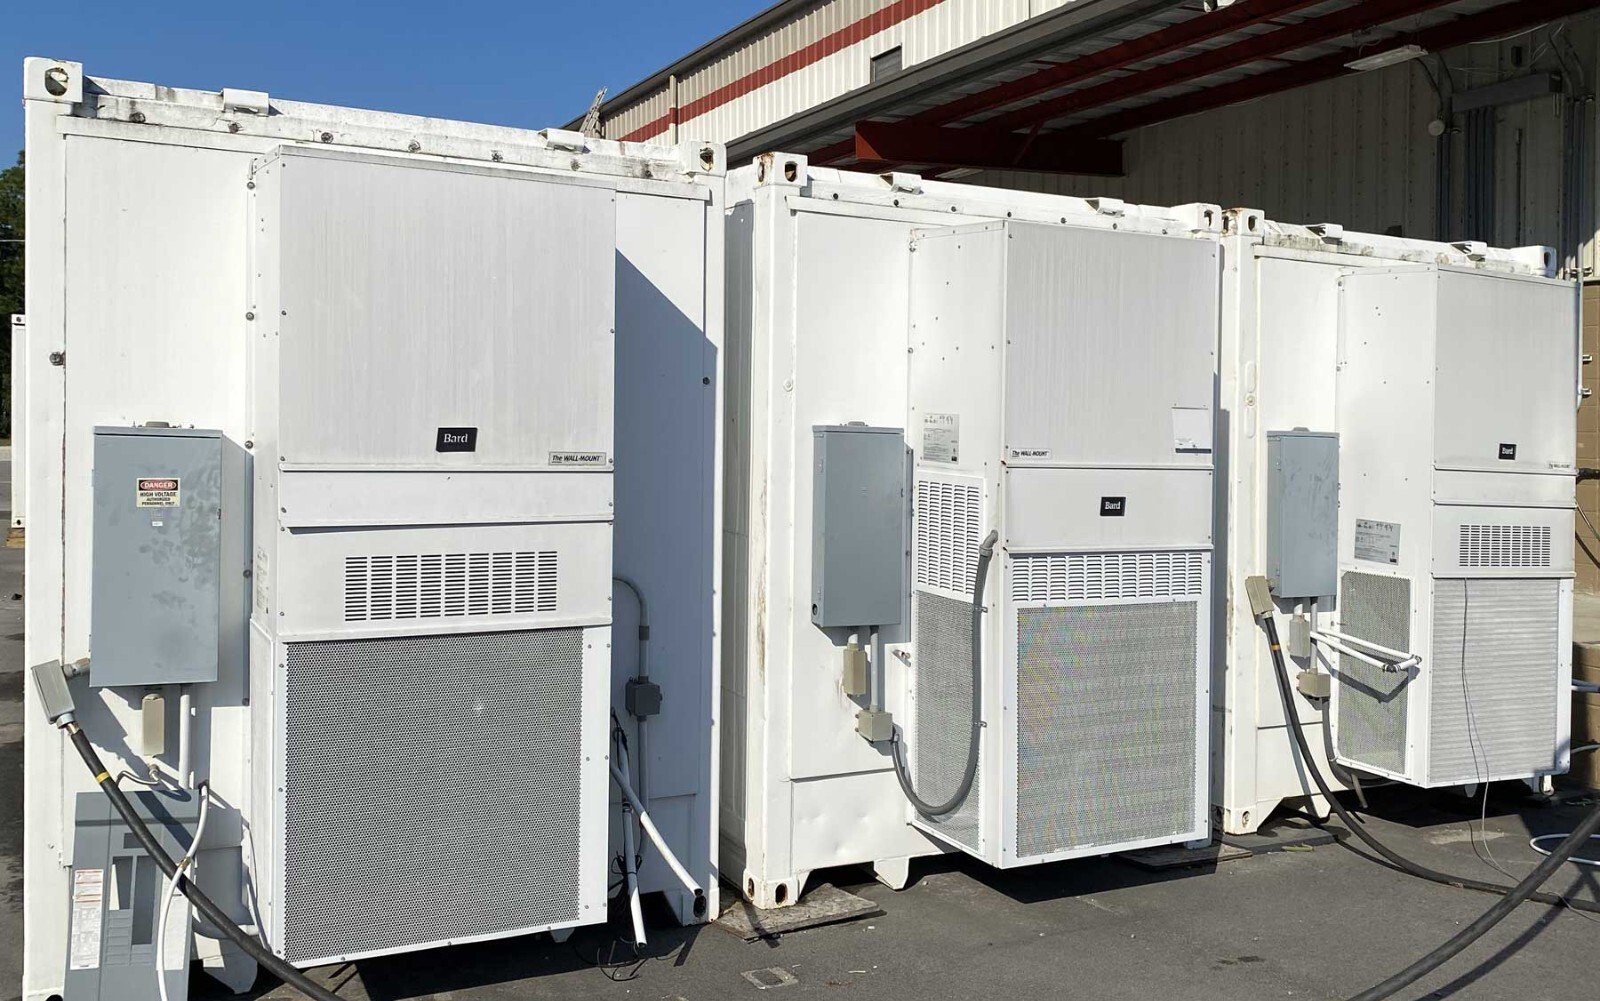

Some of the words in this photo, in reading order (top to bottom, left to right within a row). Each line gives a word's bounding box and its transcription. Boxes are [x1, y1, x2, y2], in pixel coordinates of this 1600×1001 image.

[443, 433, 468, 443] Bard
[552, 454, 563, 463] The
[563, 454, 600, 462] WALL-MOUNT
[144, 481, 173, 489] DANGER
[1105, 501, 1121, 510] Bard
